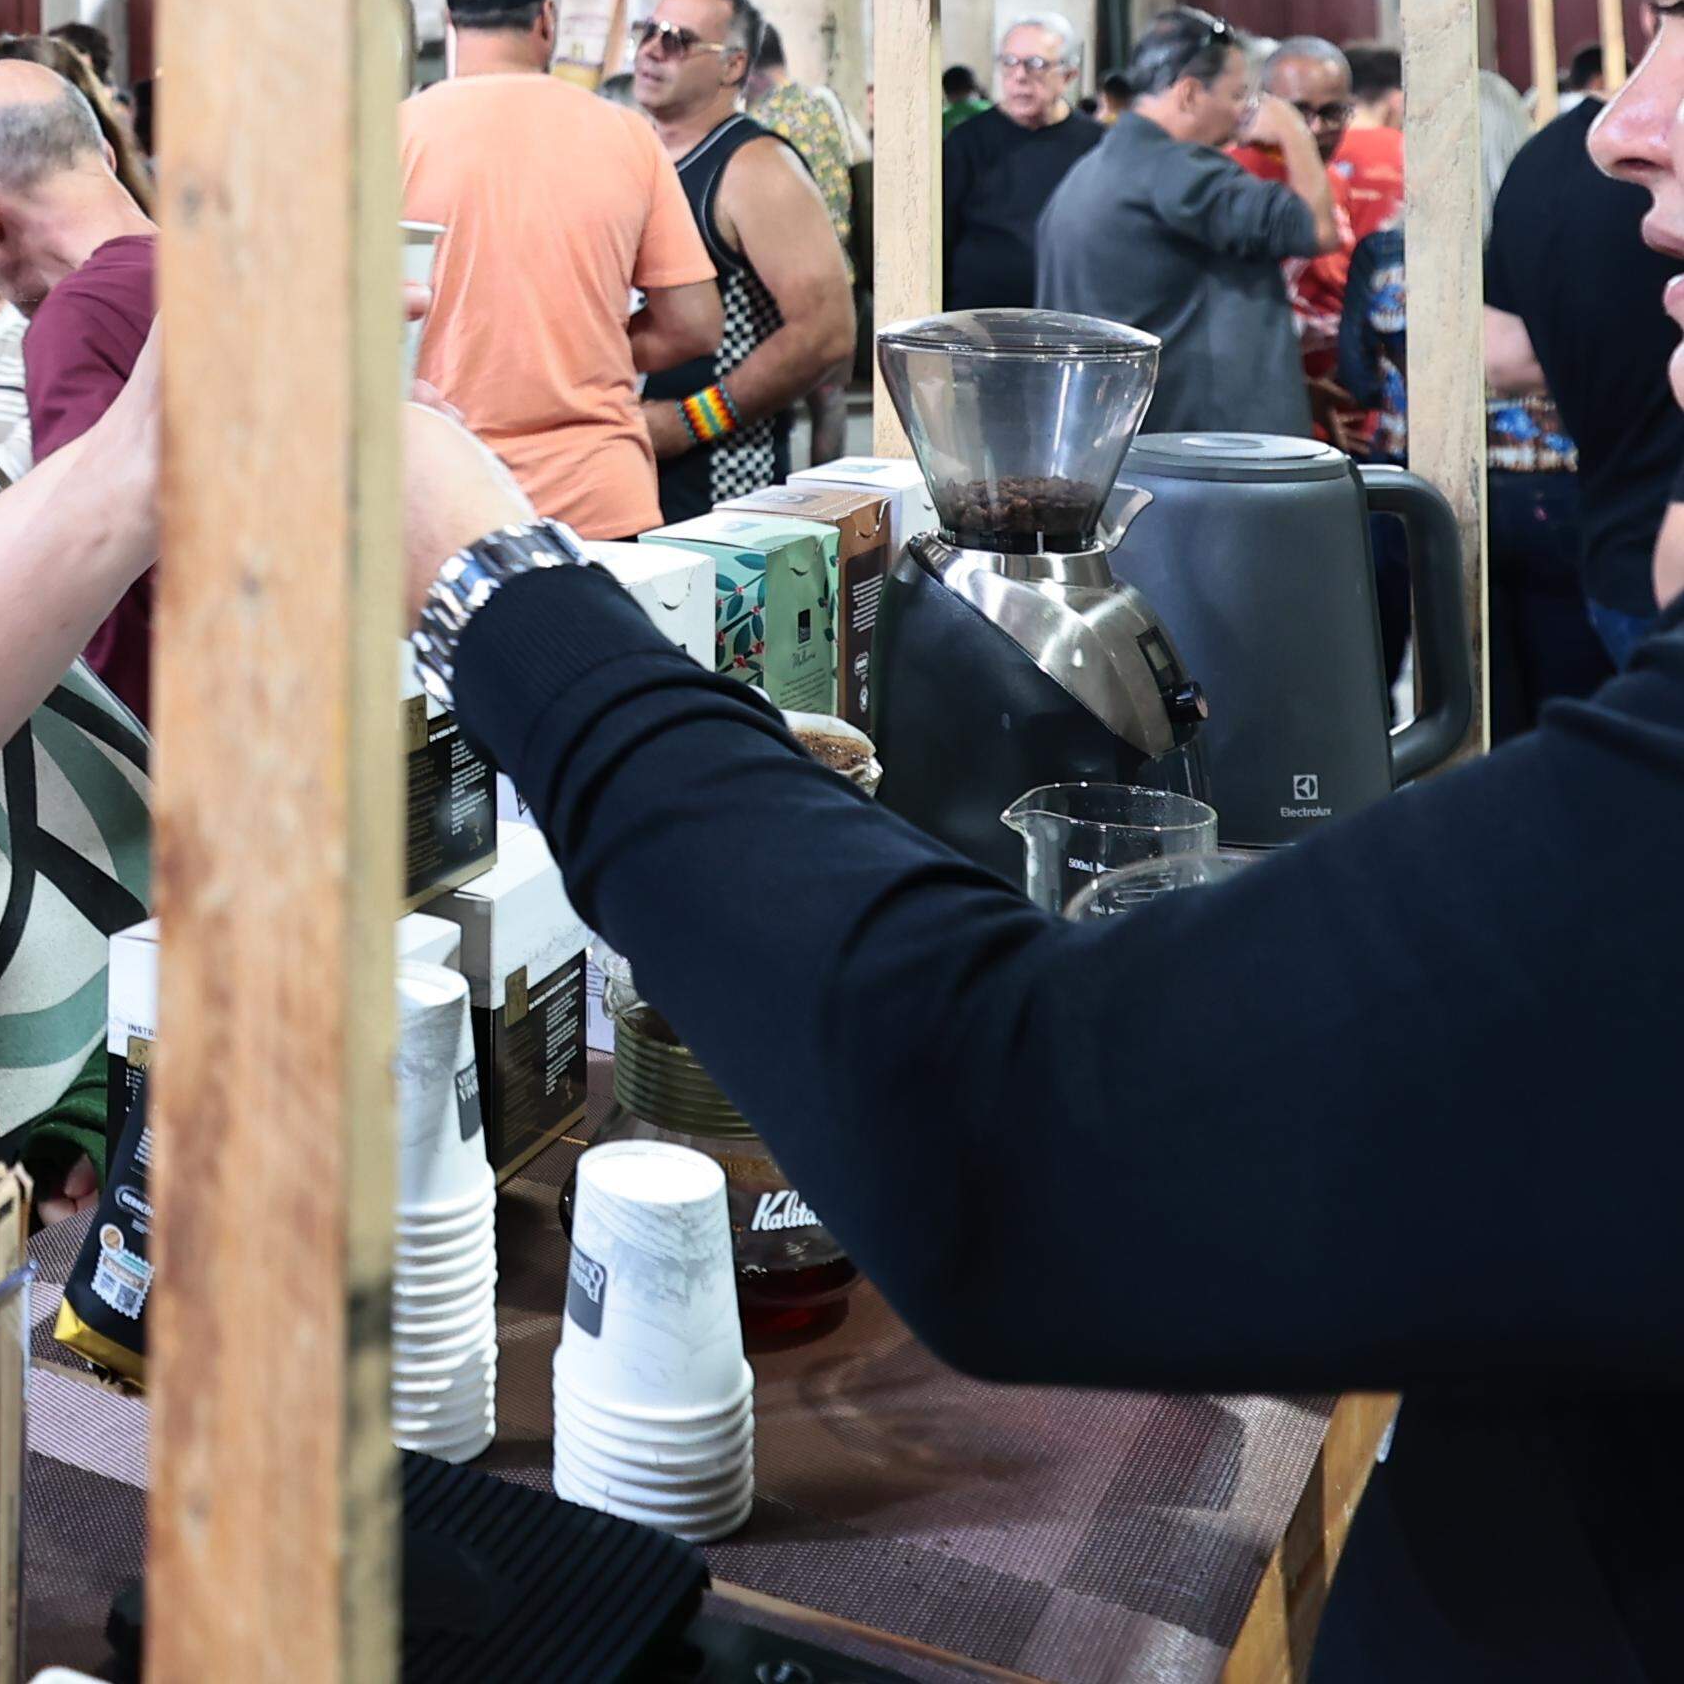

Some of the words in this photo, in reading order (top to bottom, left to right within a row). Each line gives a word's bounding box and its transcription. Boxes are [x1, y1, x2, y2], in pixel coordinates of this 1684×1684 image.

[1280, 806, 1332, 817] Electrolux
[1068, 857, 1094, 873] 500ml
[128, 1023, 157, 1036] INSTR
[751, 1189, 818, 1231] Kalita
